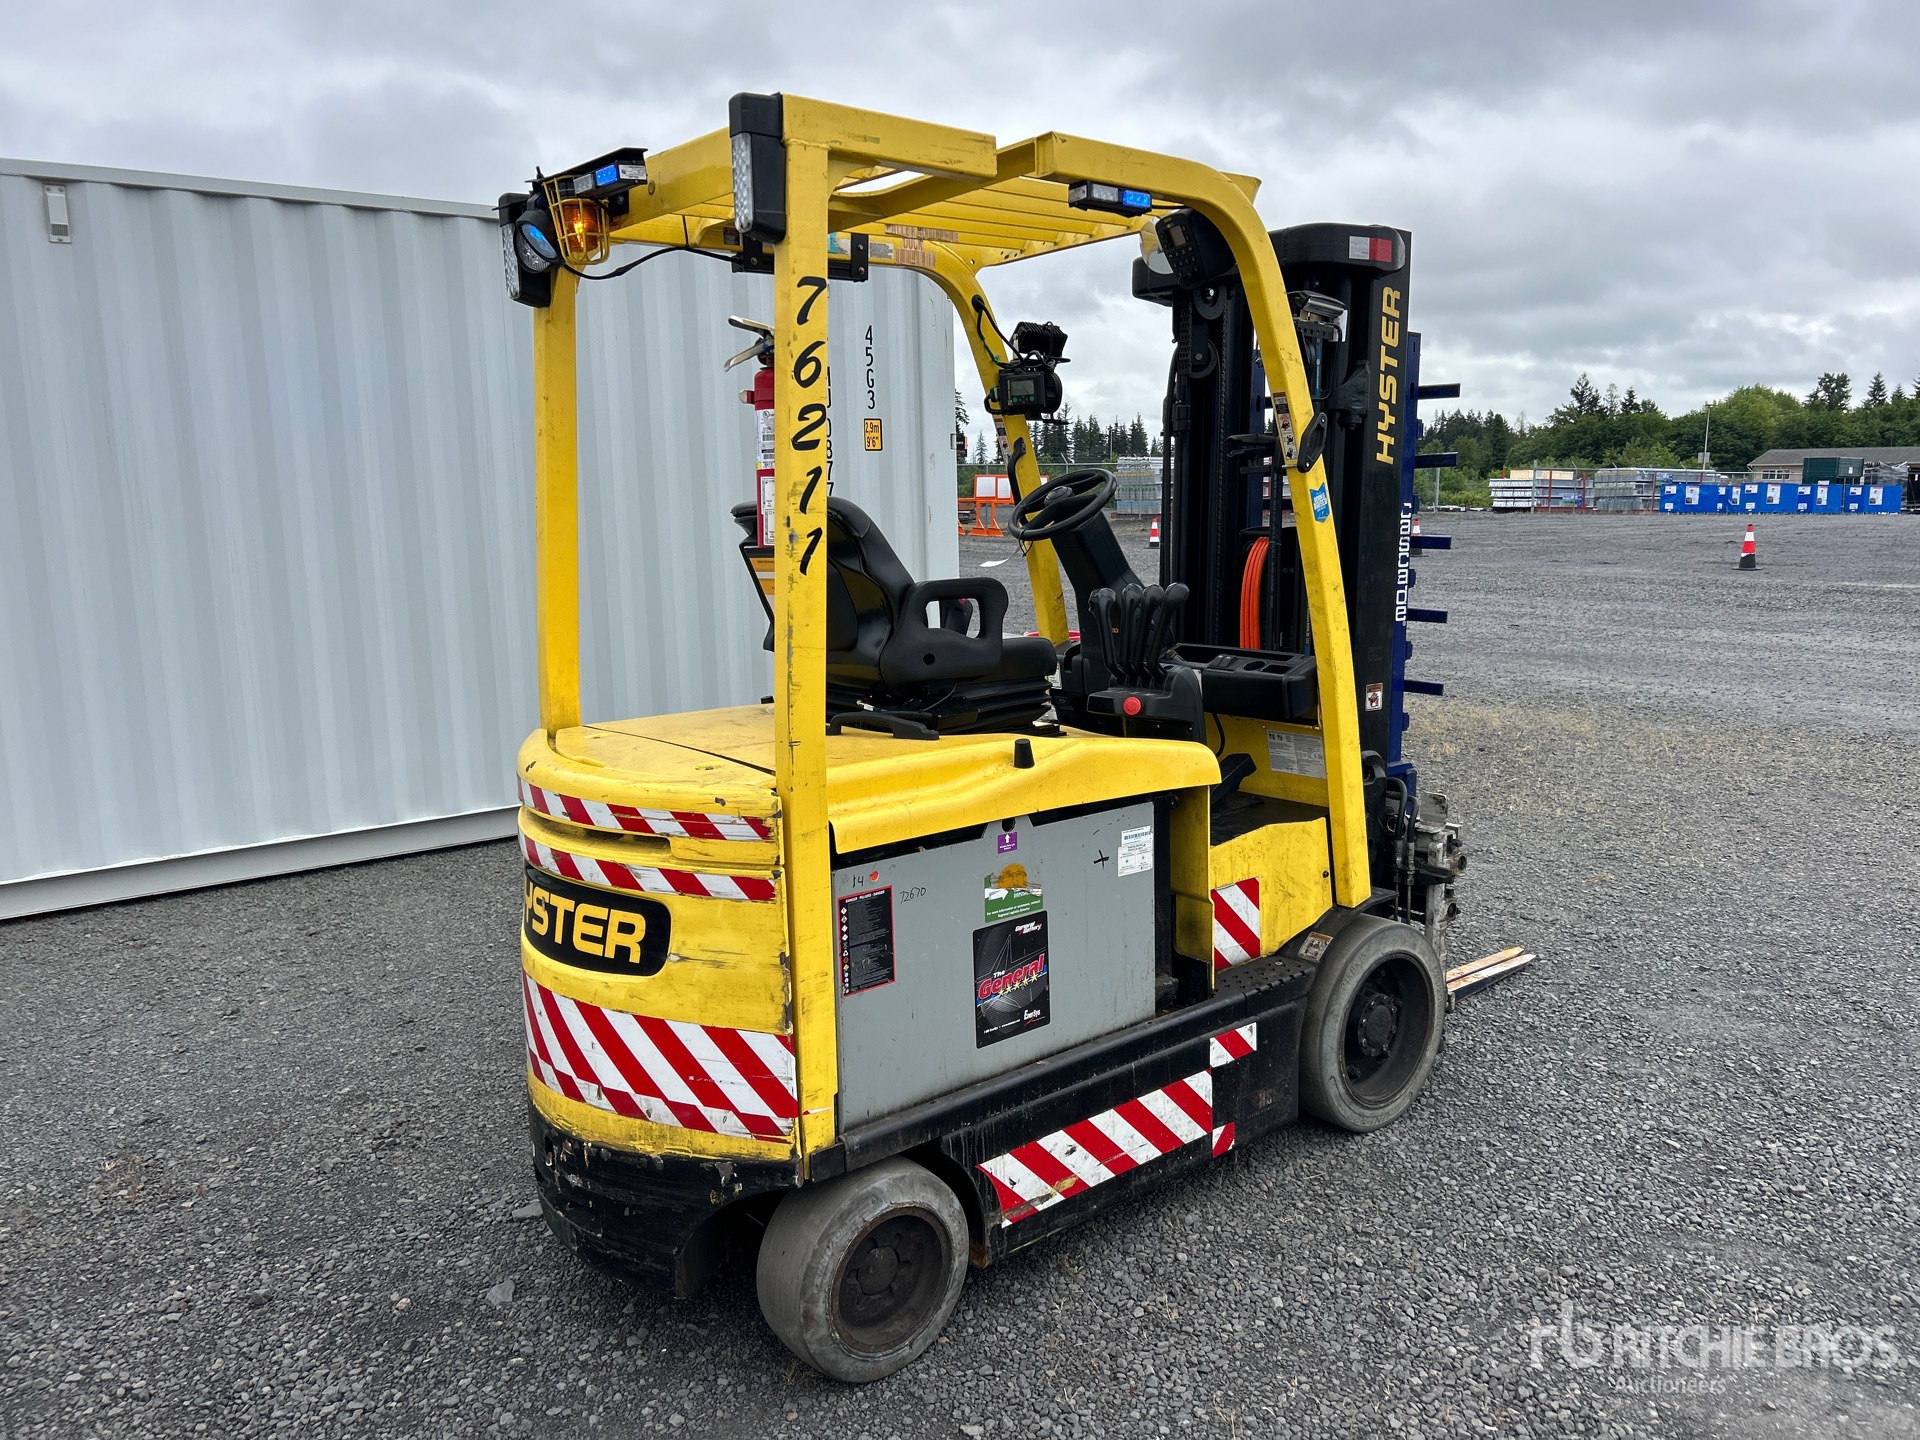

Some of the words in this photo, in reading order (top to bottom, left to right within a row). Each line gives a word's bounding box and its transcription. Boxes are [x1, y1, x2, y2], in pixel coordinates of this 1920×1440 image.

[864, 325, 876, 410] 45G3
[1376, 286, 1401, 465] HYSTER
[791, 276, 827, 576] 76211
[525, 881, 647, 964] YSTER
[978, 953, 1045, 999] General
[993, 970, 1006, 978] The
